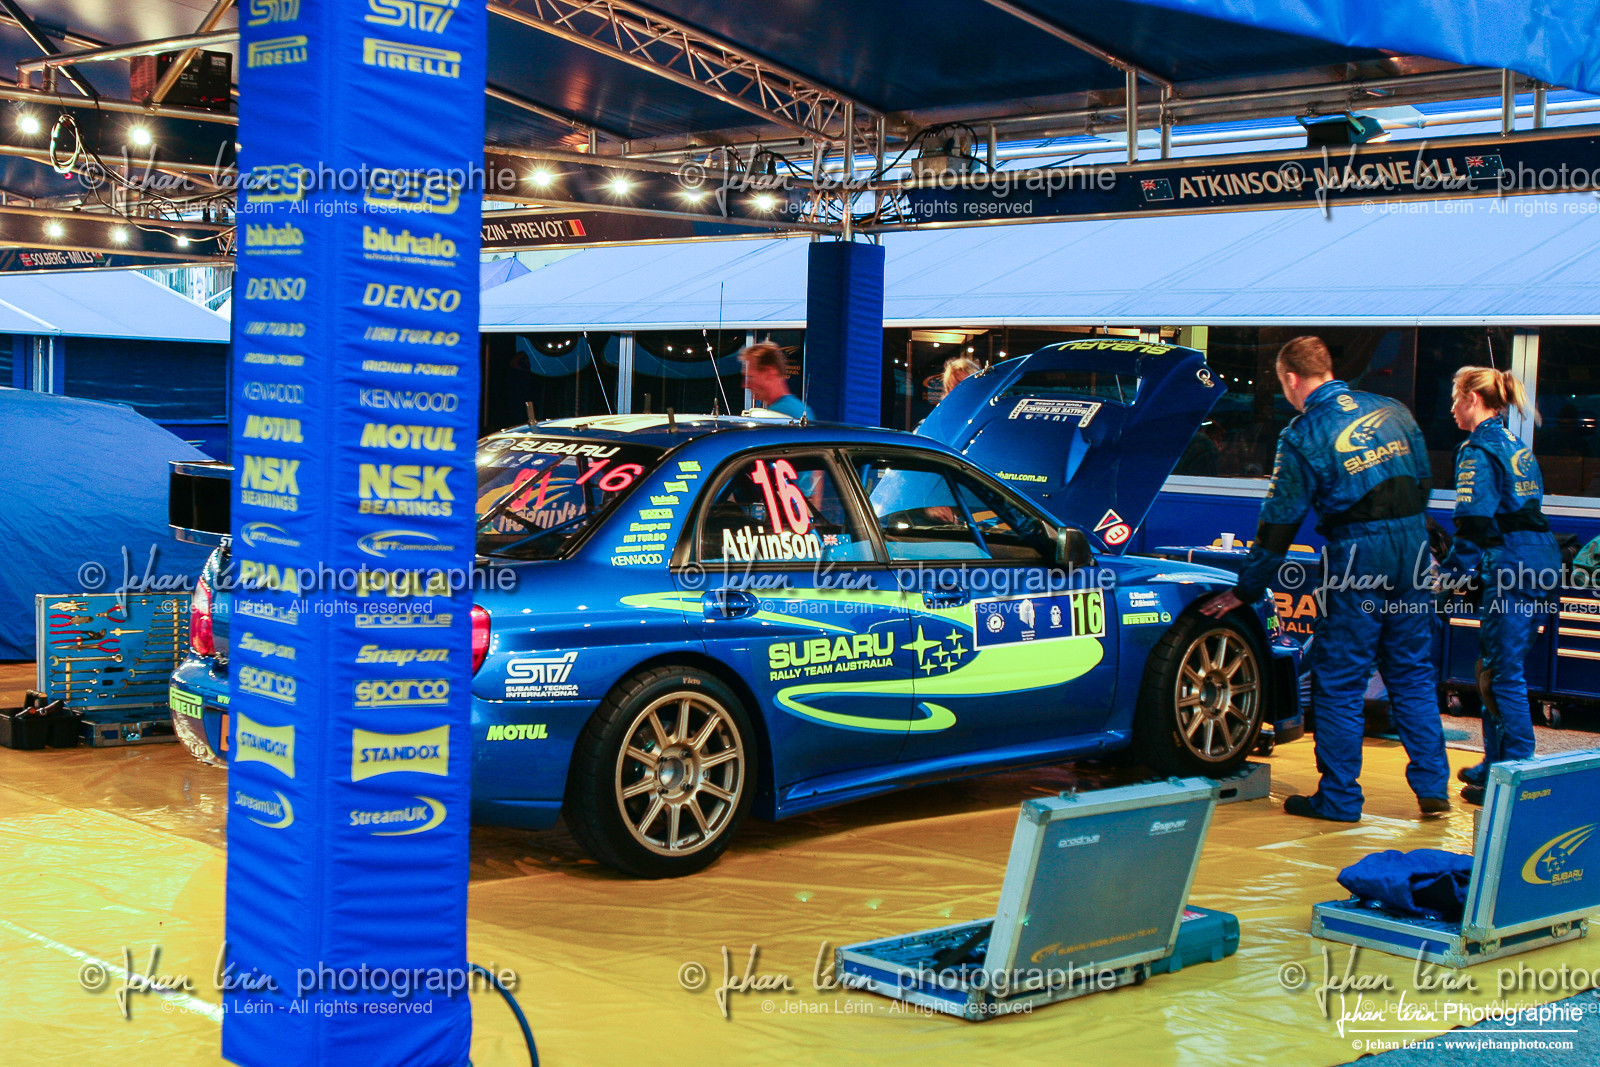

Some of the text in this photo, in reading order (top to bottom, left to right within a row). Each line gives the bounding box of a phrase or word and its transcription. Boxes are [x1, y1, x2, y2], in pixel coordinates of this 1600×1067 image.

[247, 35, 308, 68] PIRELLI
[363, 37, 462, 78] PIRELLI
[31, 251, 94, 266] SOLBERG-MILLS
[246, 278, 306, 300] DENSO
[362, 283, 460, 312] DENSO
[267, 322, 305, 337] TURBO
[399, 329, 460, 346] TURBO
[1058, 342, 1174, 355] SUBARU
[362, 360, 458, 376] IRIDIUM POWER
[243, 382, 304, 404] KENWOOD
[359, 389, 458, 412] KENWOOD
[243, 415, 304, 443] MOTUL
[360, 423, 456, 451] MOTUL
[510, 440, 621, 458] SUBARU
[241, 455, 300, 495] NSK
[359, 463, 455, 500] NSK
[575, 459, 644, 491] 16
[241, 490, 298, 512] BEARINGS
[358, 500, 452, 516] BEARINGS
[751, 459, 810, 535] 16
[637, 532, 668, 542] TURBO
[722, 525, 821, 562] Atkinson
[1109, 527, 1126, 541] E
[611, 553, 663, 566] KENWOOD
[355, 613, 453, 628] prodrive
[1073, 592, 1103, 635] 16
[1122, 612, 1159, 625] PIRELLI
[238, 633, 297, 660] Snap-on
[769, 632, 895, 671] SUBARU
[770, 658, 894, 682] RALLY TEAM AUSTRALIA
[238, 665, 297, 698] sparco
[355, 680, 449, 705] sparco
[169, 687, 203, 719] PIRELLI
[505, 690, 578, 698] INTERNATIONAL
[486, 724, 548, 741] MOTUL
[239, 731, 289, 758] STANDOX
[359, 745, 441, 763] STANDOX
[234, 790, 284, 818] StreamUK
[1520, 789, 1552, 801] Snap-on
[349, 805, 428, 826] StreamUK
[1552, 869, 1584, 882] SUBARU
